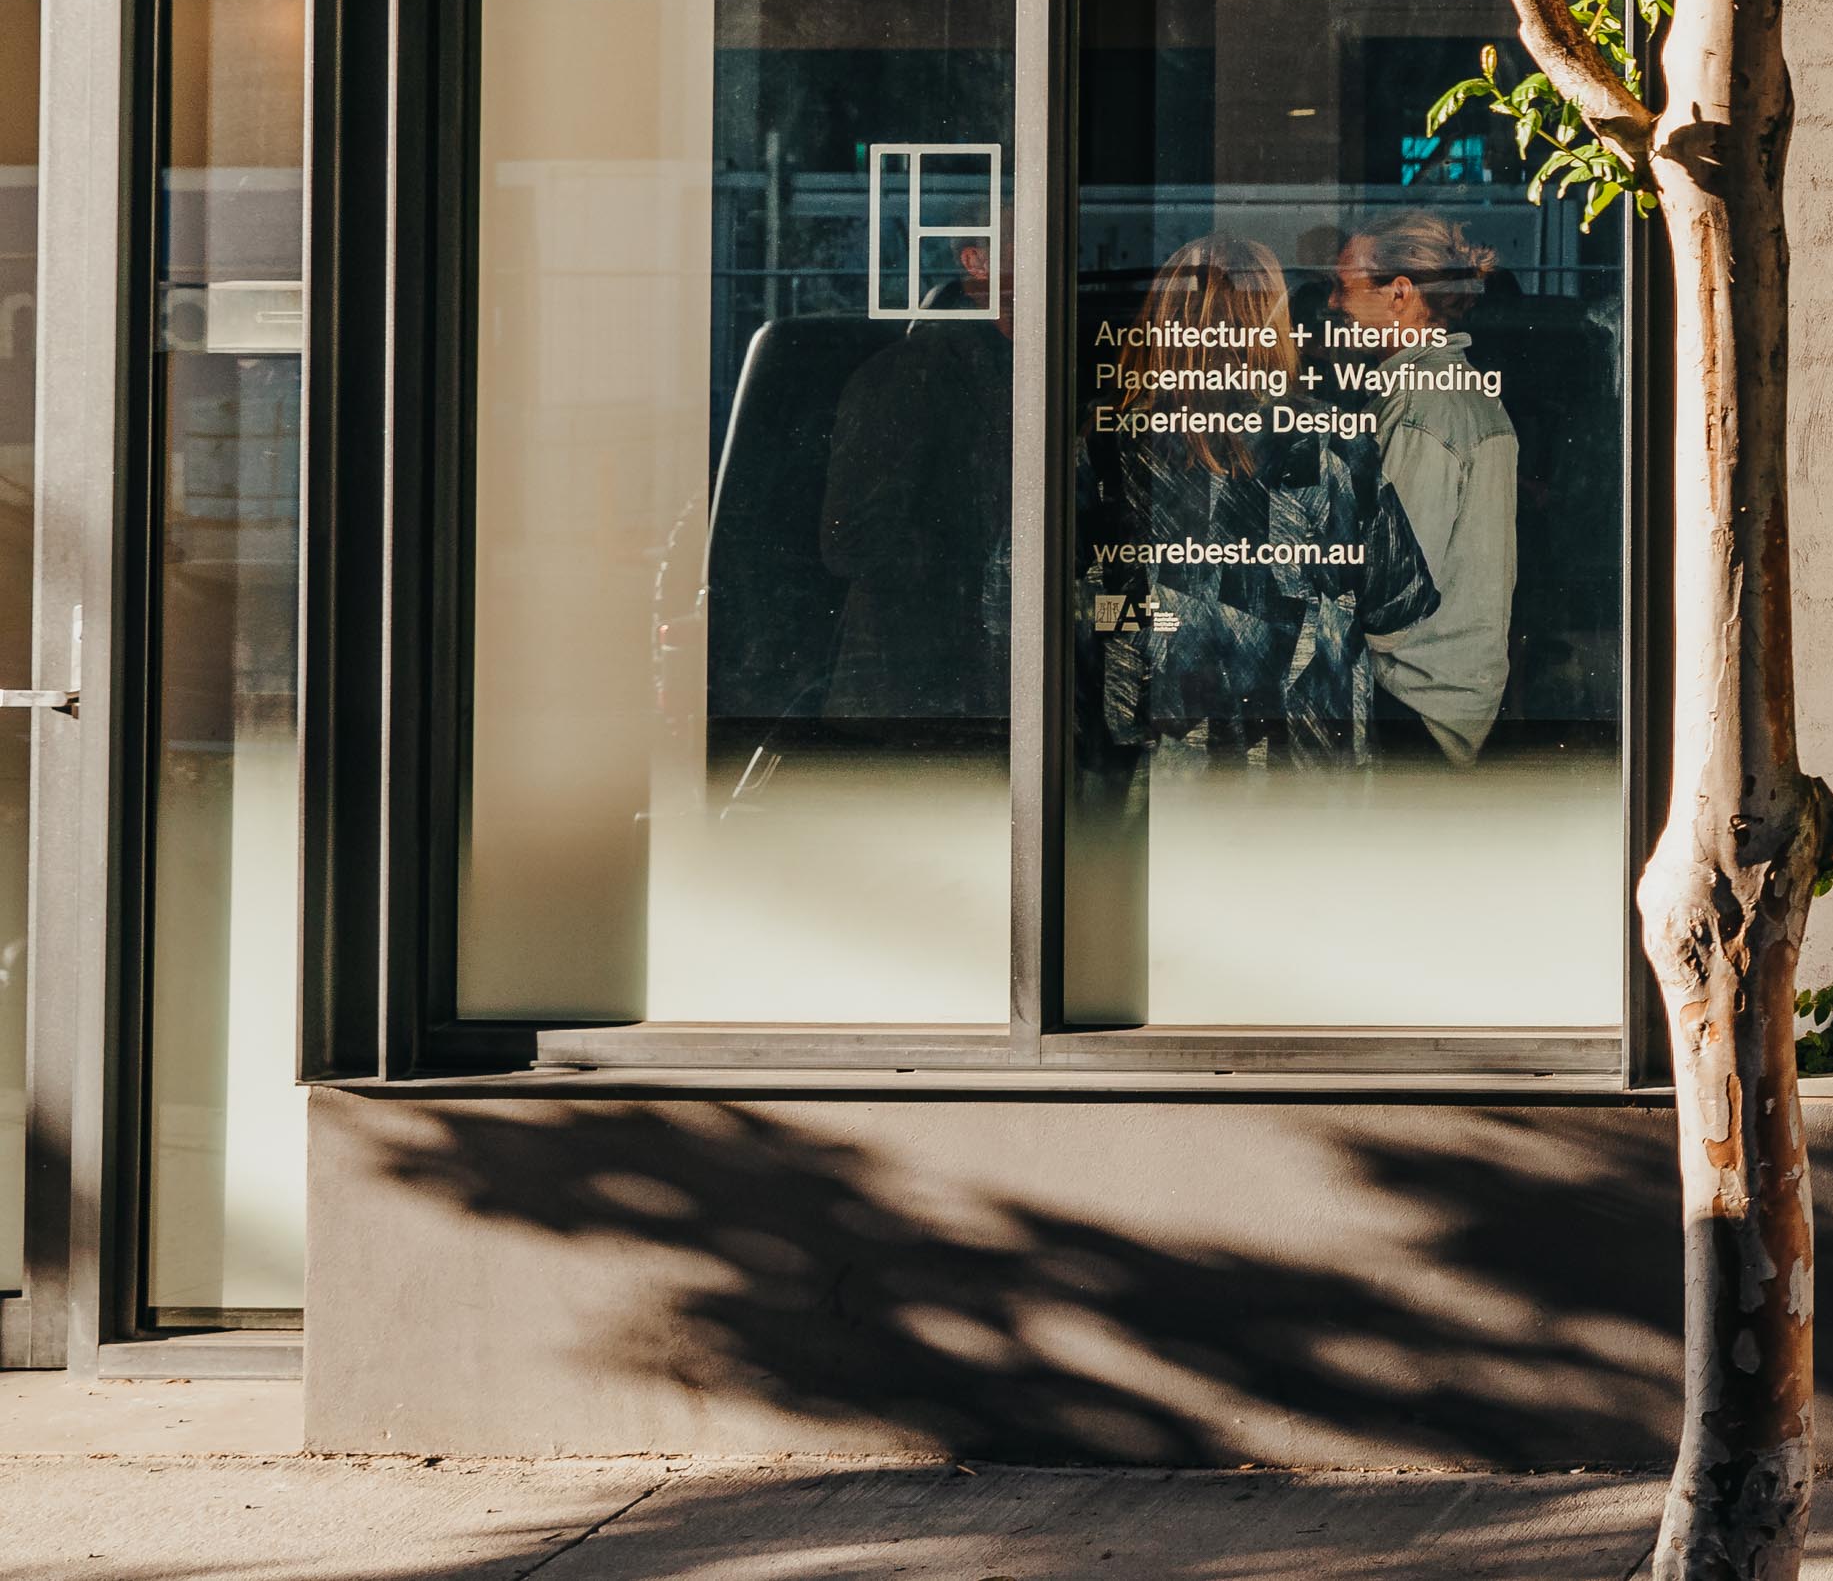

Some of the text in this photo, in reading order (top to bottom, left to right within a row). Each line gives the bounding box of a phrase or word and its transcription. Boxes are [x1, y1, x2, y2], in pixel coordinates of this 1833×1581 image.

[1094, 321, 1447, 348] Architecture + Interiors
[1096, 363, 1501, 397] Placemaking + Wayfinding
[1096, 406, 1377, 440] Experience Design
[1092, 537, 1364, 565] wearebest.com.au
